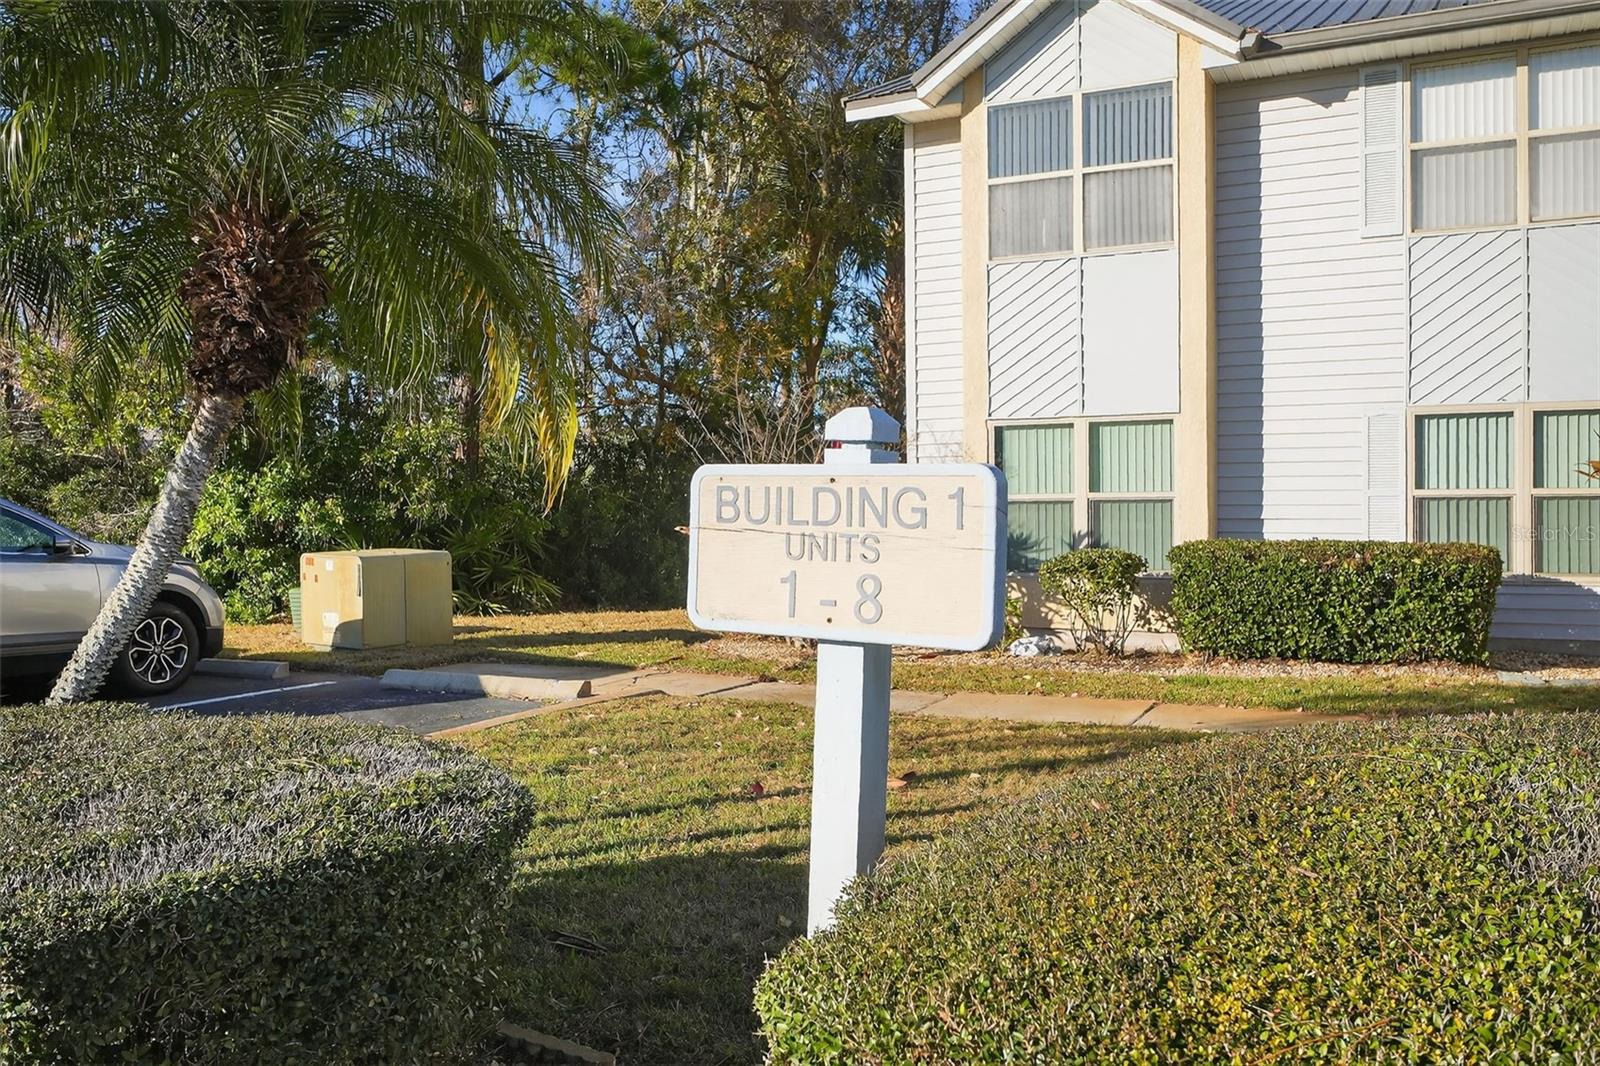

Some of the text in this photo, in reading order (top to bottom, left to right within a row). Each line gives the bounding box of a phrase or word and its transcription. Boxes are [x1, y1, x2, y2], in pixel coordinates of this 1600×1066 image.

[715, 485, 965, 530] BUILDING 1
[785, 532, 881, 564] UNITS
[780, 570, 797, 618] 1
[853, 573, 883, 625] 8
